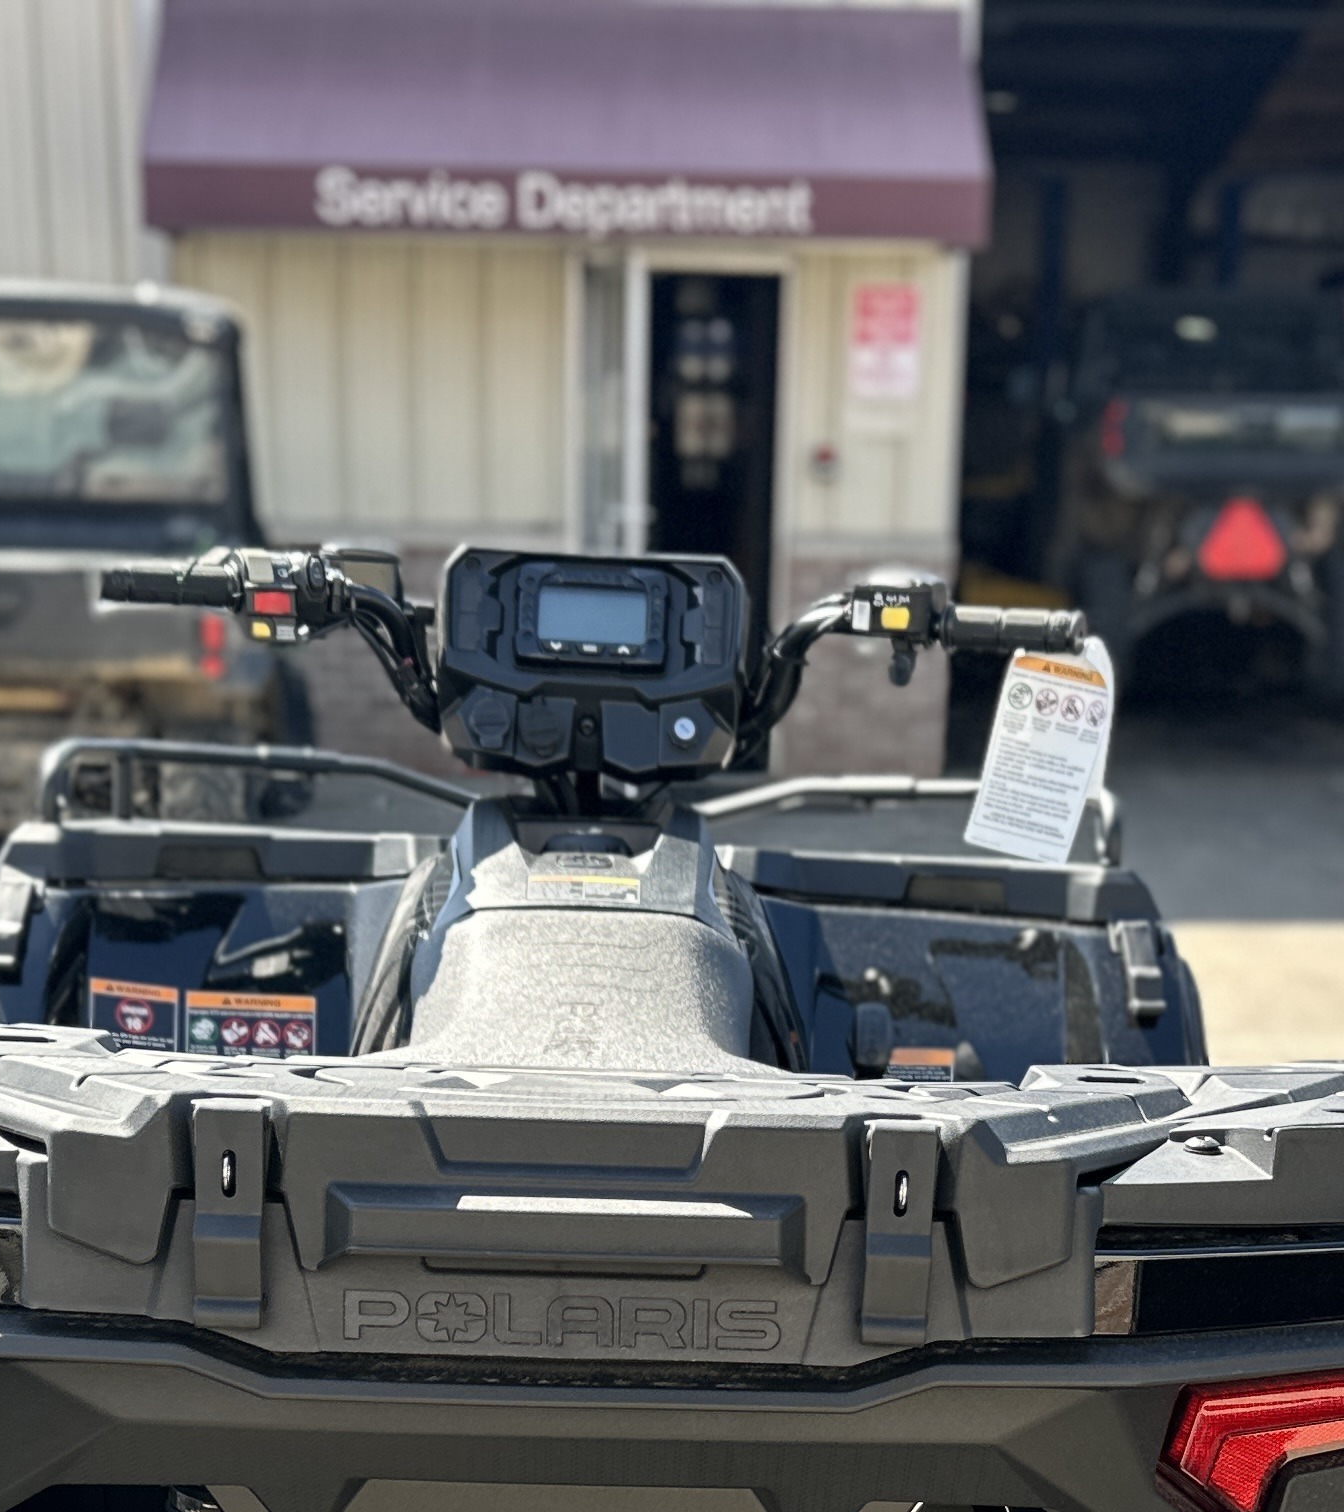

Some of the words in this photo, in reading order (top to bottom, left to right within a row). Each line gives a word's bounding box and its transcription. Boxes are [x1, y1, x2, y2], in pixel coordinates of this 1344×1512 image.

[311, 164, 509, 230] Service
[516, 170, 814, 240] Department
[1052, 664, 1096, 683] WARNING
[342, 1288, 783, 1352] POLARIS
